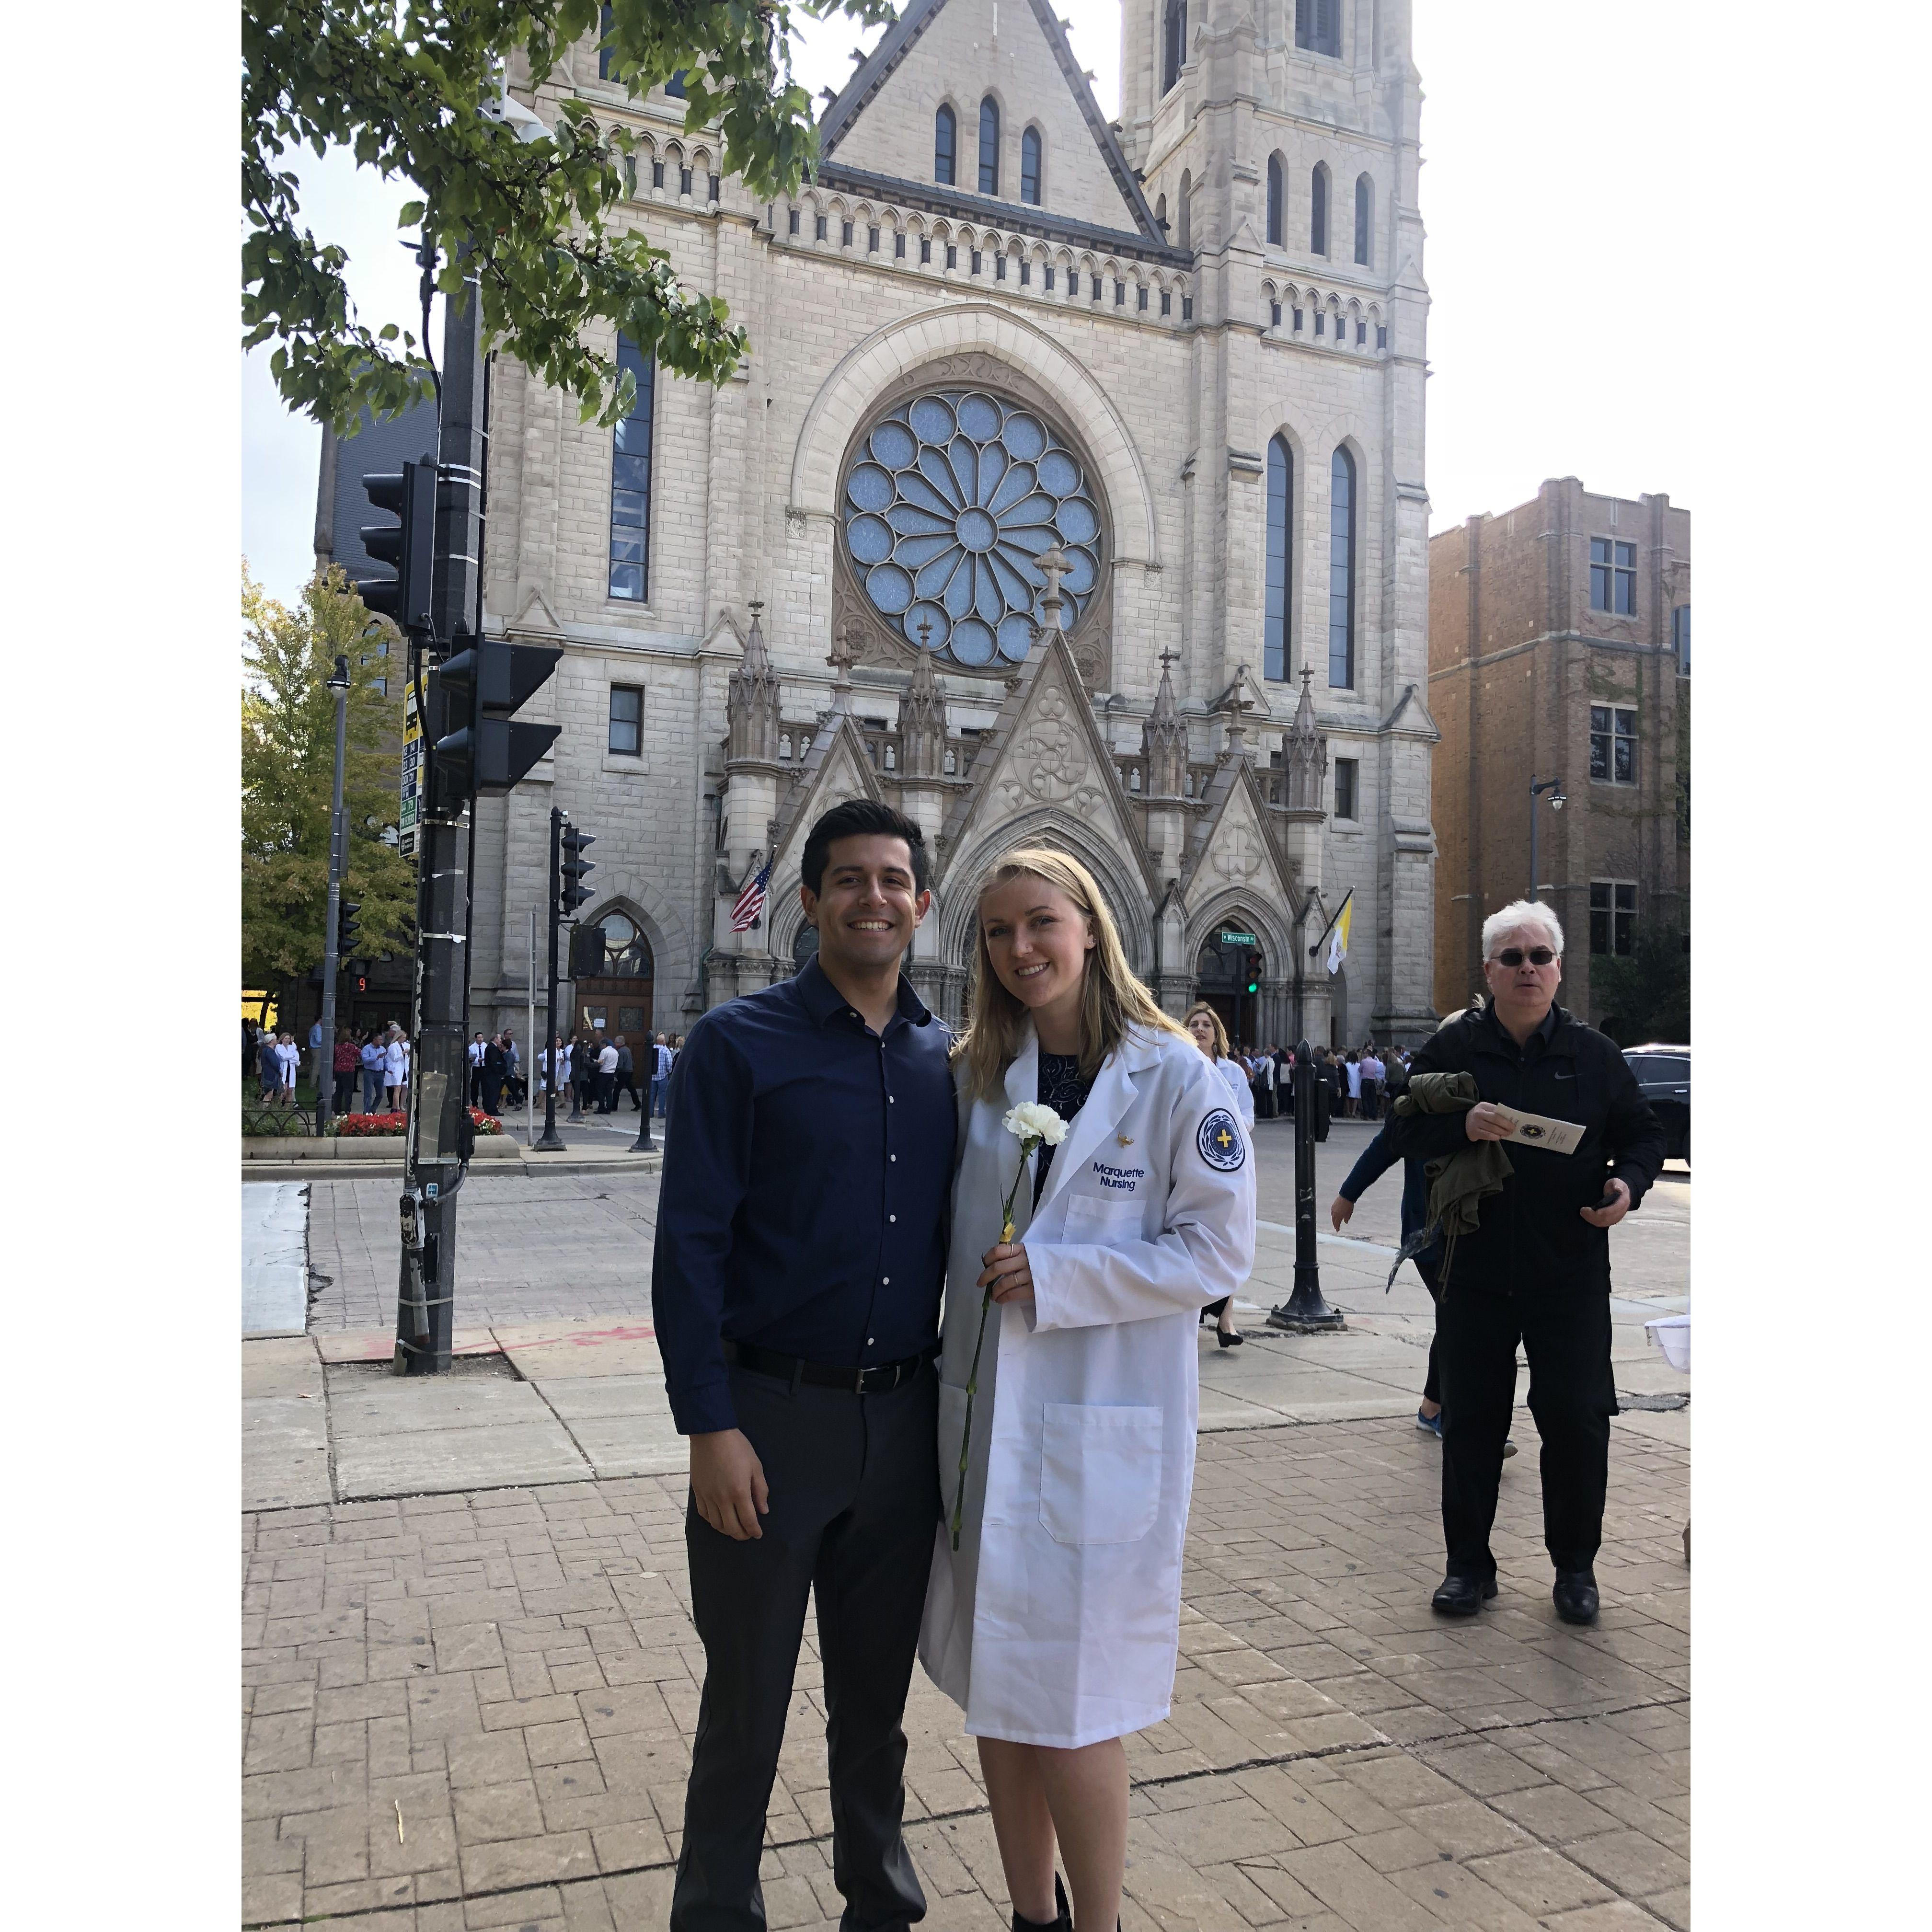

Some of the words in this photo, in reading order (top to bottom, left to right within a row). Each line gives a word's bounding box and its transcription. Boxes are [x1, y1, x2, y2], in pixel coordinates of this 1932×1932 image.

[403, 760, 408, 770] 23
[410, 757, 415, 767] 30
[408, 799, 414, 811] 79
[1227, 934, 1250, 943] Wisconsin
[360, 978, 365, 991] 9
[1093, 1162, 1144, 1178] Marquette
[1100, 1175, 1136, 1192] Nursing
